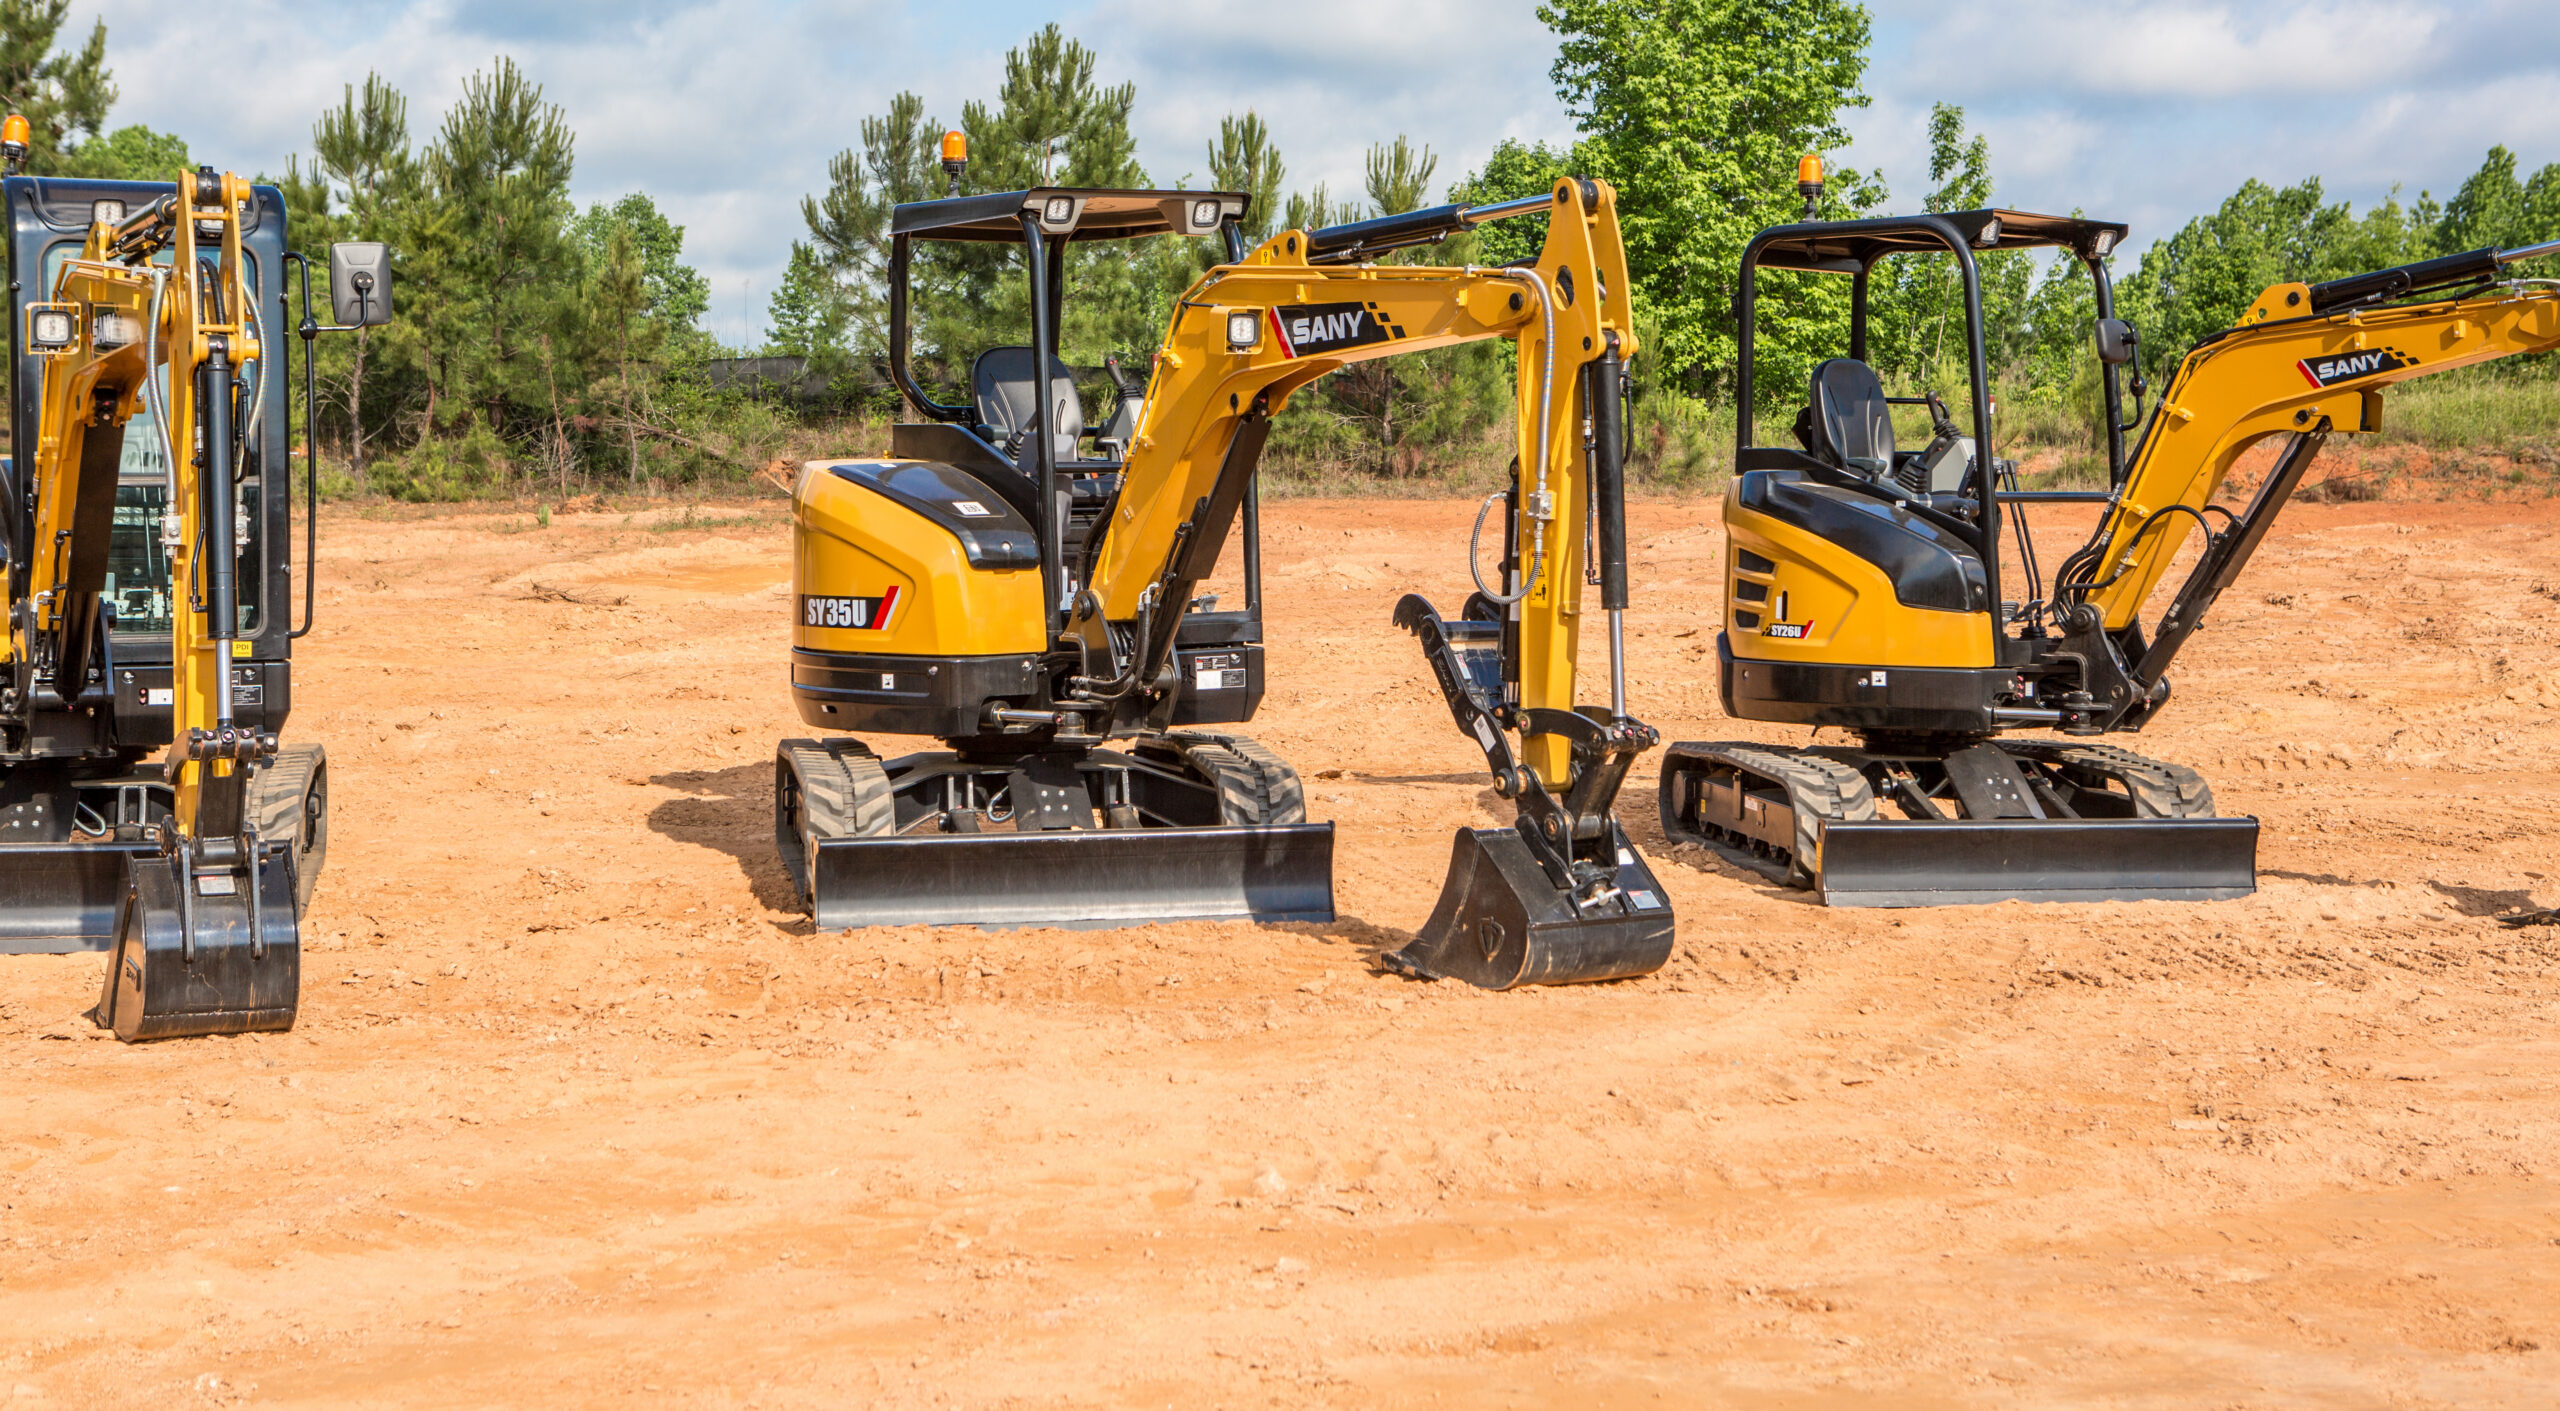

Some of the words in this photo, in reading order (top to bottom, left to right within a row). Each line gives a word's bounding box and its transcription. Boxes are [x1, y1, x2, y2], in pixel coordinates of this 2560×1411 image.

[1293, 310, 1364, 345] SANY
[2318, 351, 2384, 380] SANY
[807, 598, 867, 627] SY35U
[1771, 624, 1802, 638] SY26U
[236, 643, 249, 651] PDI
